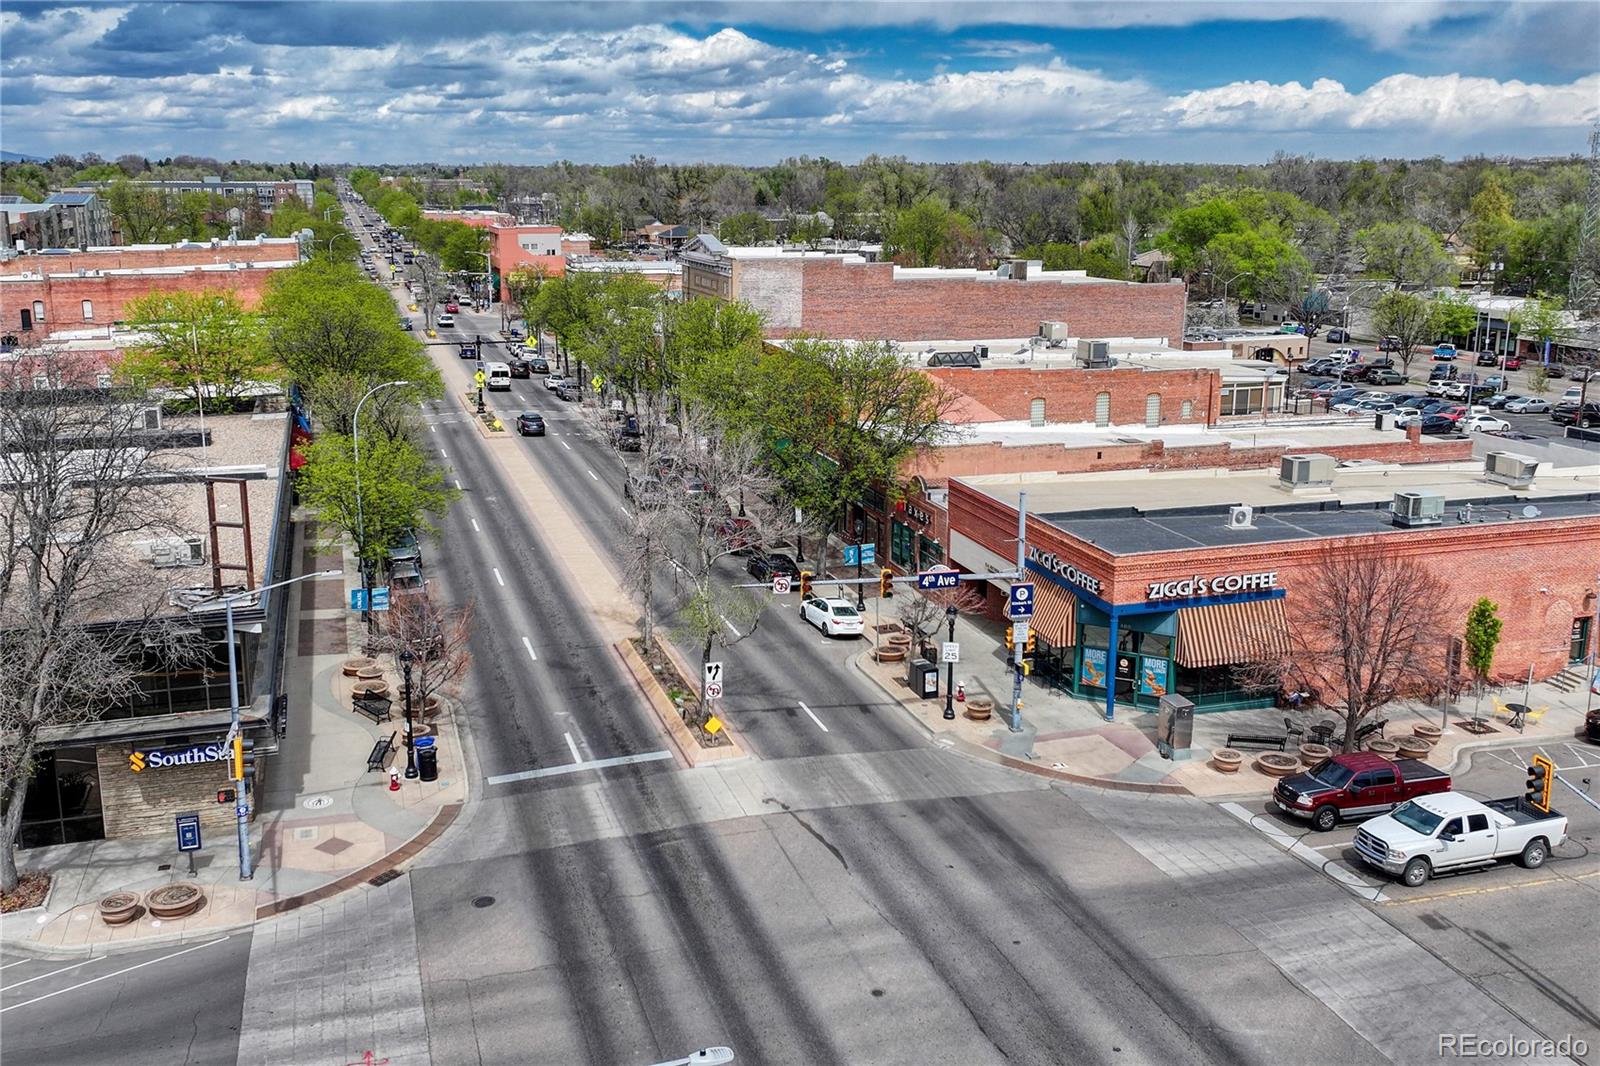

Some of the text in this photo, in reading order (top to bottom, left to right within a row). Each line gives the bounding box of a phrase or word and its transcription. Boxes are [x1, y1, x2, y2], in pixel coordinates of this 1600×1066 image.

[903, 501, 930, 524] axes
[922, 575, 956, 587] 4th Ave
[1060, 563, 1099, 595] COFFEE
[1148, 572, 1278, 599] ZIGGI'S COFFEE
[944, 652, 958, 660] 25
[1085, 647, 1107, 660] MORE
[1144, 657, 1168, 669] MORE
[148, 745, 236, 768] SouthSta
